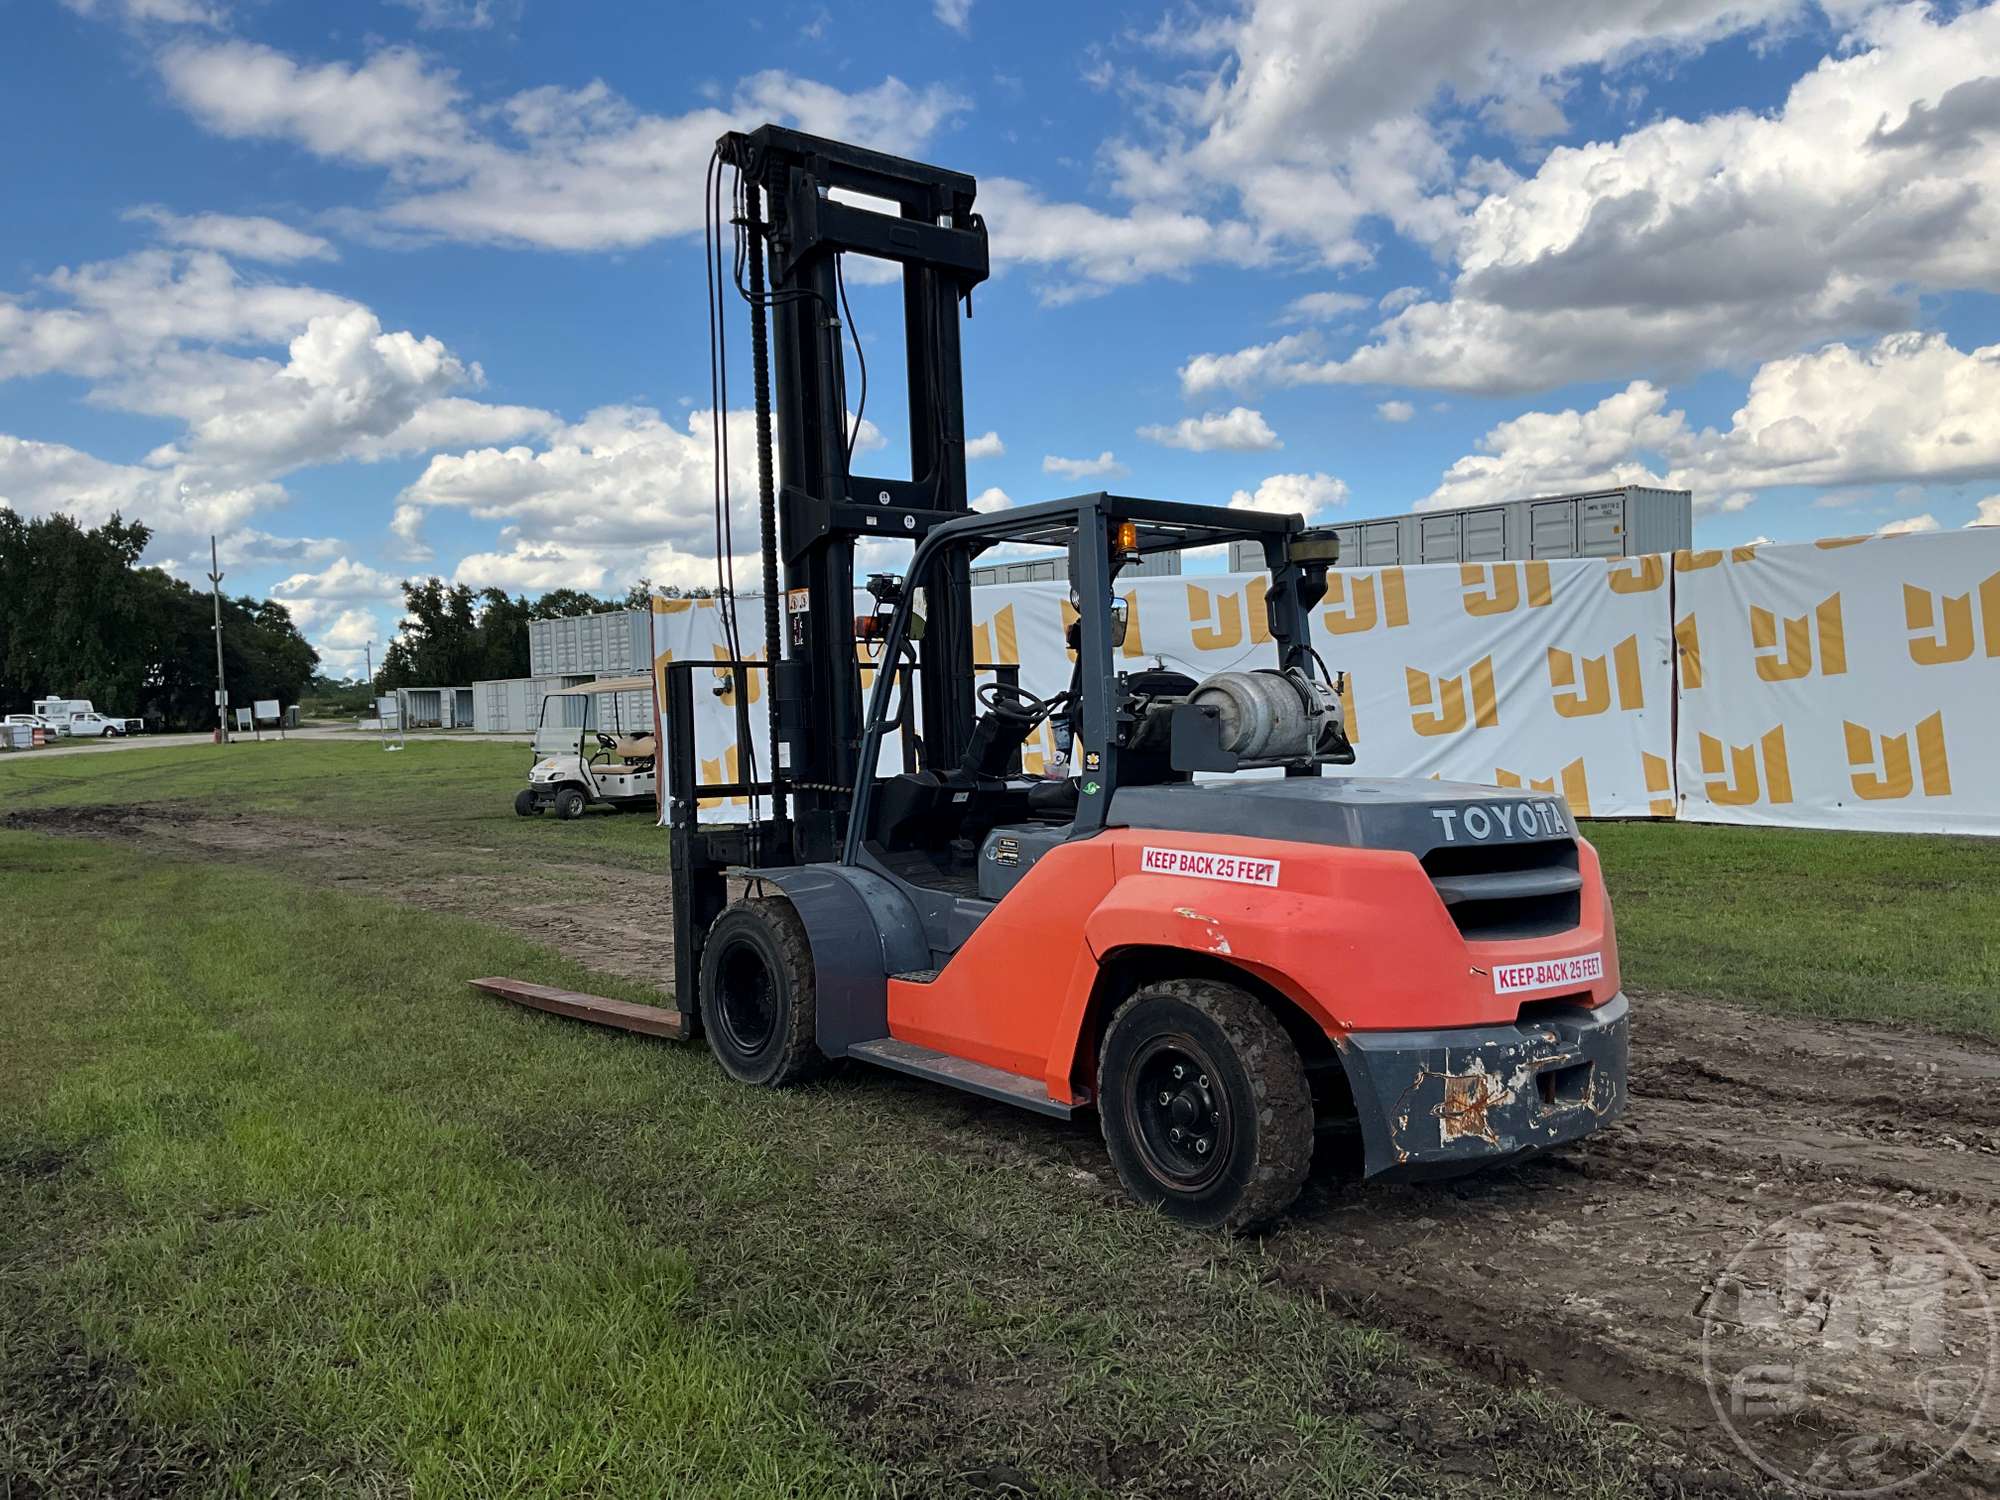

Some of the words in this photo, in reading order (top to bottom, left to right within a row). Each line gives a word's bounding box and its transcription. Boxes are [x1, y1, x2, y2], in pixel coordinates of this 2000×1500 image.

[1432, 802, 1568, 841] TOYOTA
[1146, 850, 1177, 870] KEEP
[1180, 854, 1214, 875] BACK
[1216, 858, 1235, 877] 25
[1237, 861, 1274, 882] FEET
[1498, 967, 1534, 989] KEEP
[1536, 962, 1569, 984] BACK
[1569, 961, 1582, 979] 25
[1582, 957, 1600, 977] FEET
